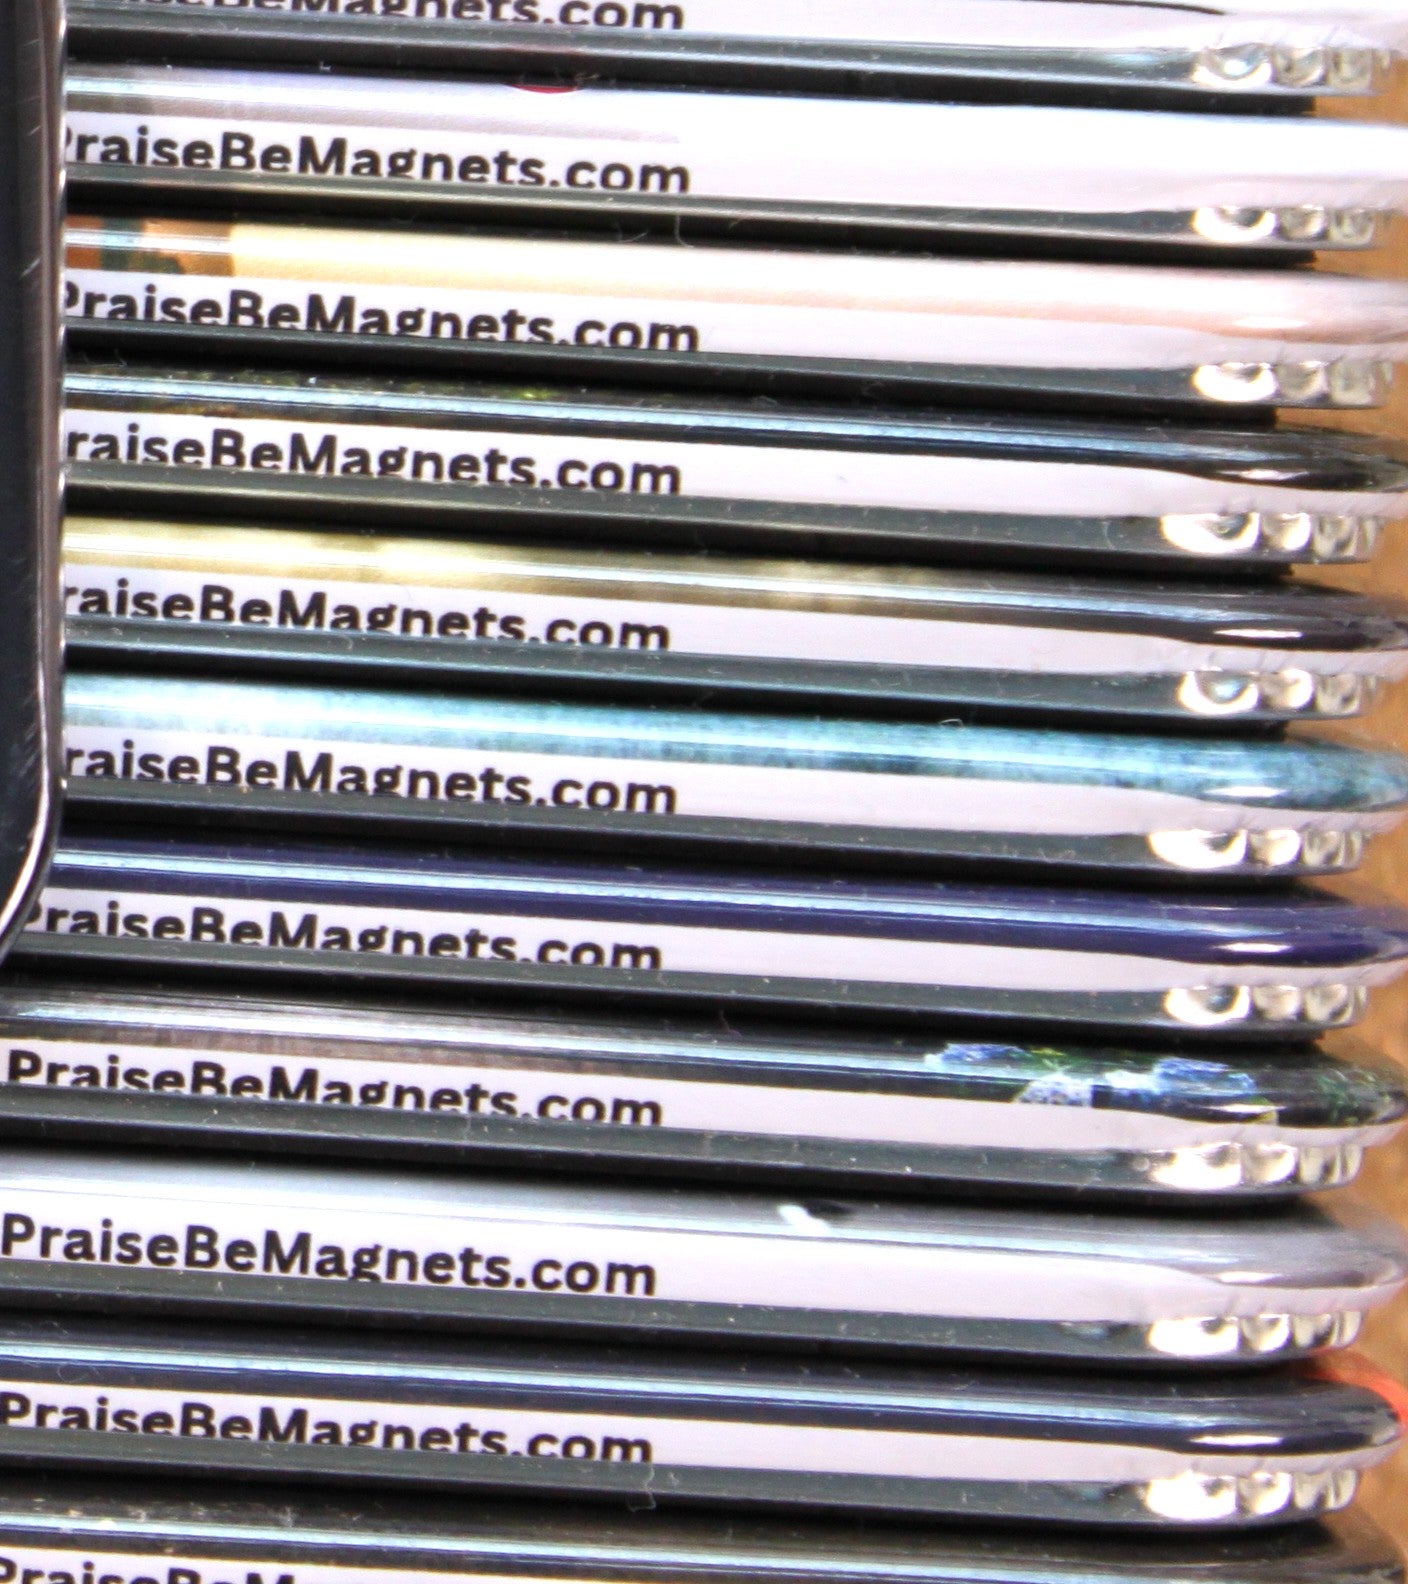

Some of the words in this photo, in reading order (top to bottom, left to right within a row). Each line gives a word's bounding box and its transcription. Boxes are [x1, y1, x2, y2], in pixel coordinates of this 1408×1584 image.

[65, 125, 690, 193] raiseBeMagnets.com
[67, 422, 681, 493] raiseBeMagnets.com
[1, 1213, 656, 1296] PraiseBeMagnets.com
